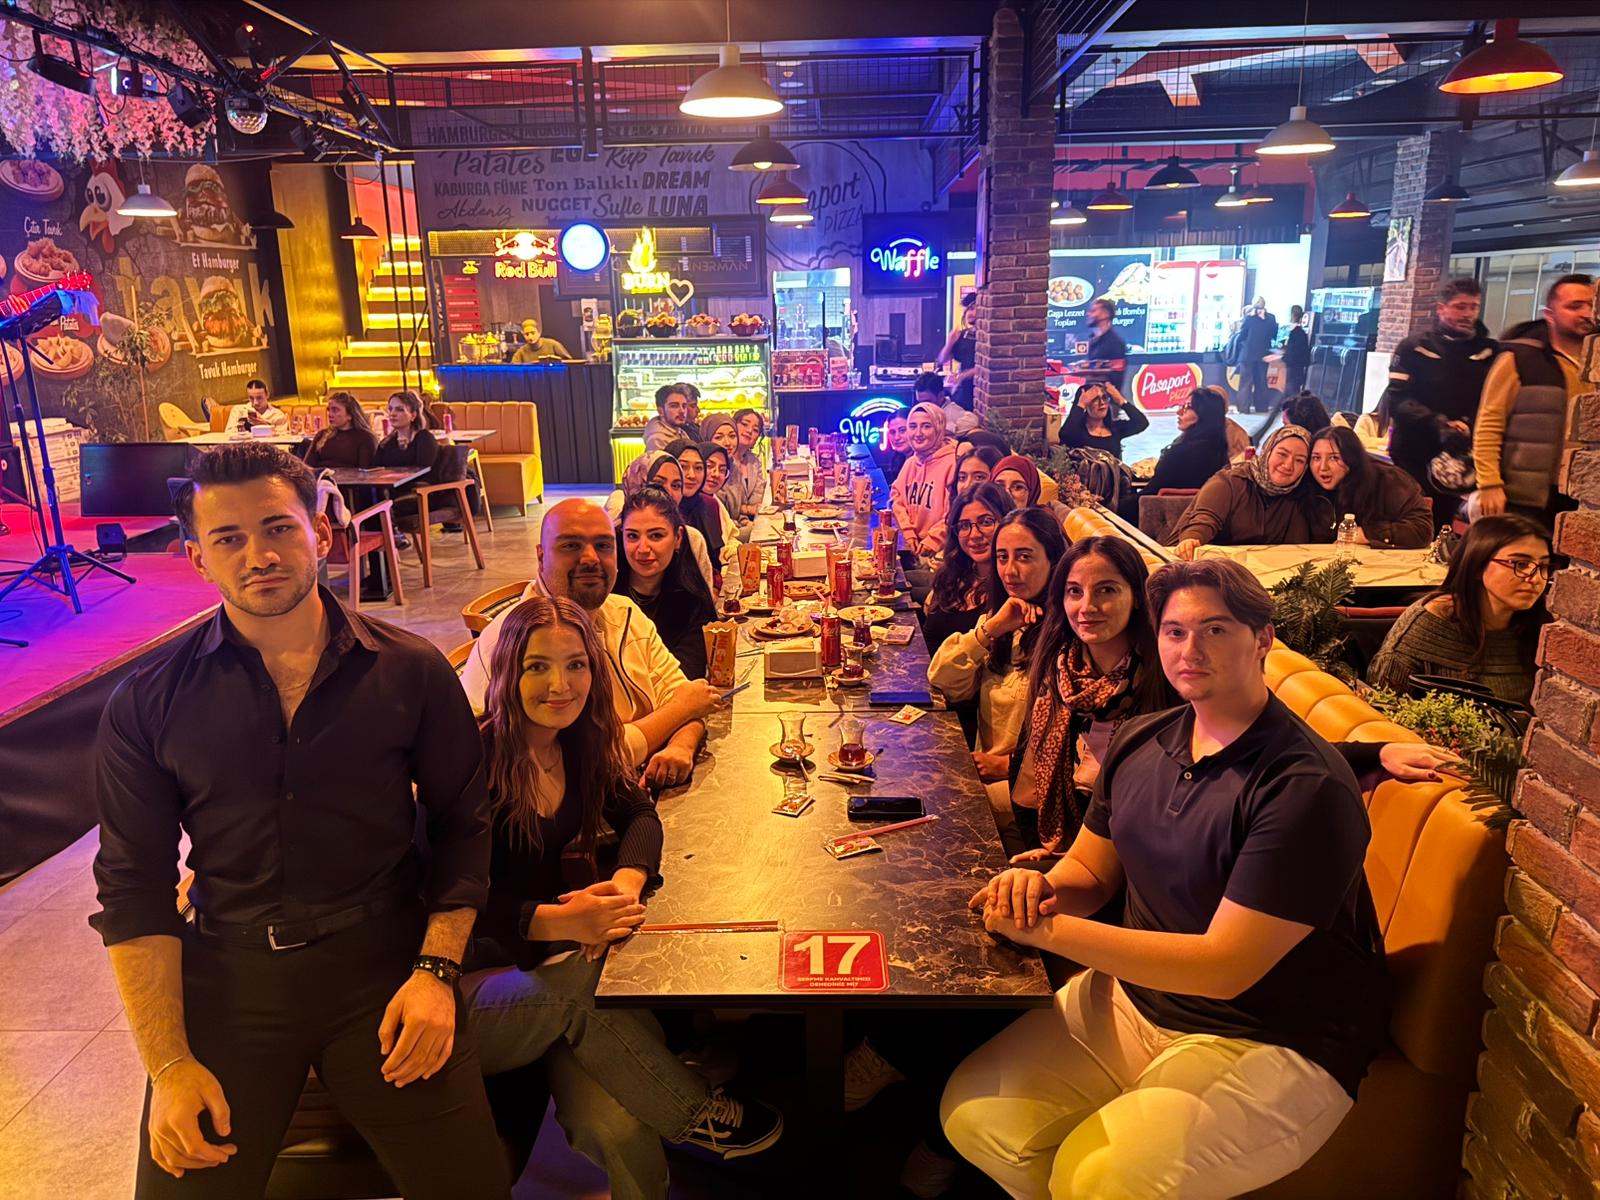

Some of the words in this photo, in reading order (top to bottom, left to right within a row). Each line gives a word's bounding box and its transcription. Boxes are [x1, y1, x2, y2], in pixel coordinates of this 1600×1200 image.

[438, 149, 545, 177] Patates
[656, 144, 716, 168] Tavuk
[434, 181, 491, 197] KABURGA
[494, 178, 529, 196] FÜME
[533, 178, 568, 192] Ton
[574, 176, 638, 191] Balıklı
[641, 170, 711, 190] DREAM
[521, 197, 592, 212] NUGGET
[647, 195, 709, 217] LUNA
[807, 172, 861, 221] aport
[824, 204, 864, 235] PIZZA
[191, 252, 200, 268] Et
[202, 252, 240, 273] Hamburger
[495, 260, 525, 278] Red
[528, 259, 558, 279] Bull
[870, 245, 939, 277] Waffle
[621, 271, 671, 291] BURN
[1112, 318, 1135, 327] Burger
[198, 361, 221, 379] Tavuk
[221, 360, 257, 377] Hamburger
[1141, 370, 1191, 397] Pasaport
[793, 935, 871, 975] 17
